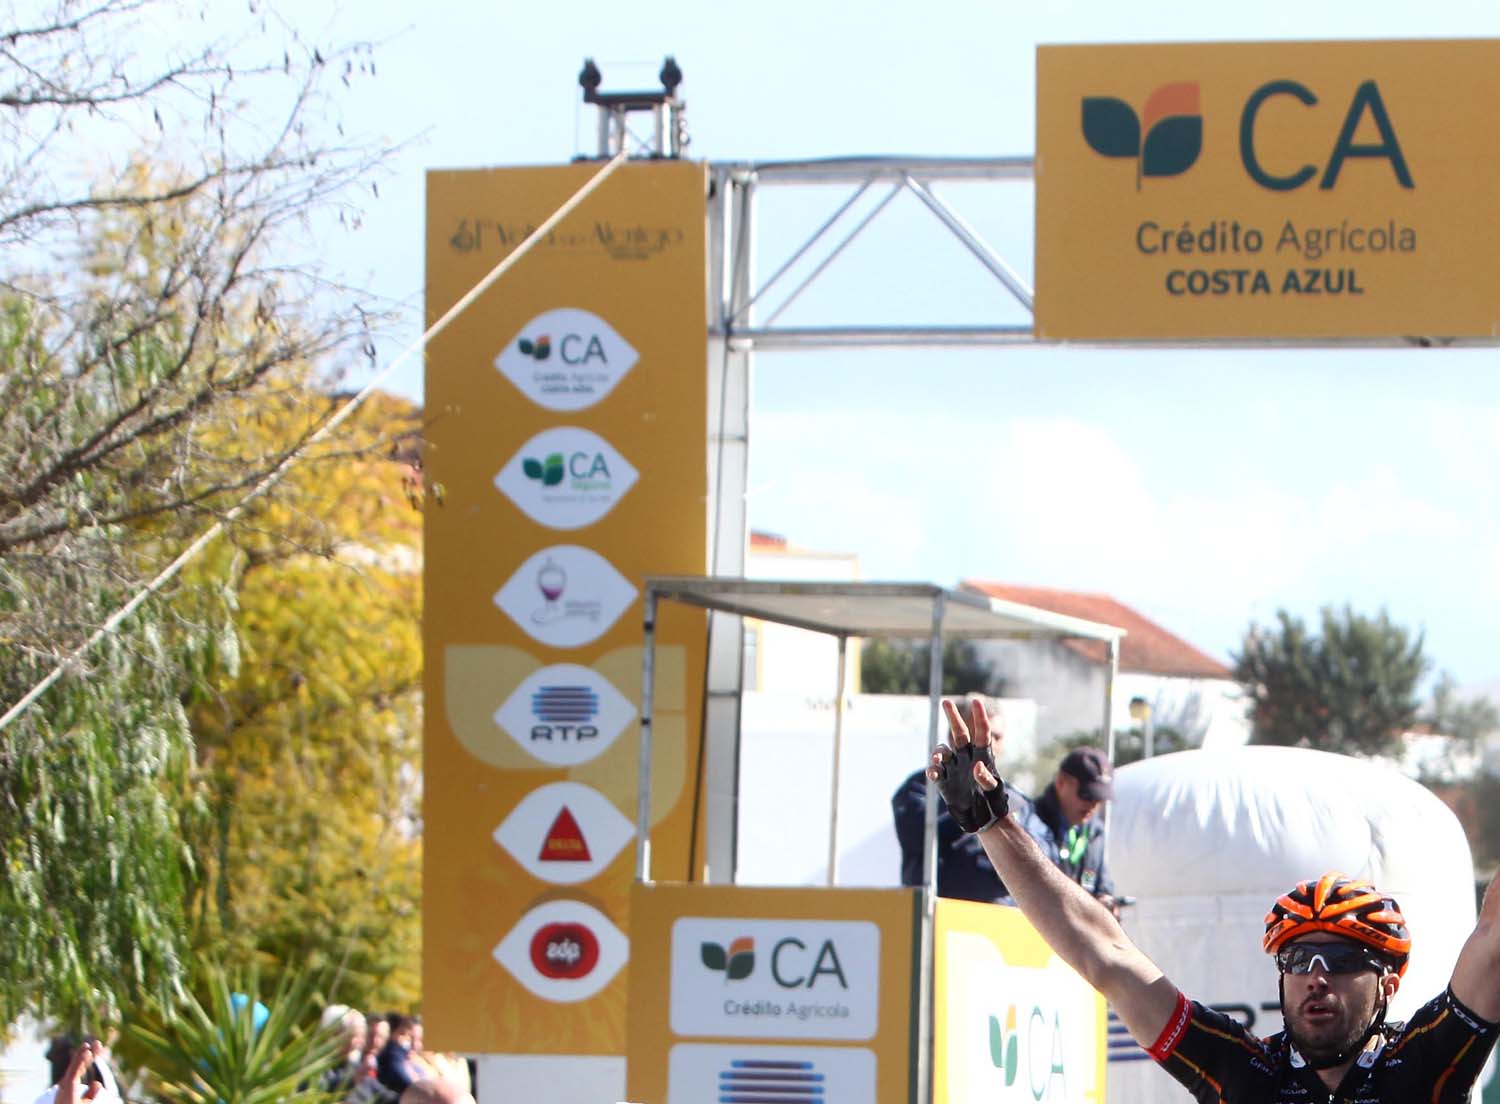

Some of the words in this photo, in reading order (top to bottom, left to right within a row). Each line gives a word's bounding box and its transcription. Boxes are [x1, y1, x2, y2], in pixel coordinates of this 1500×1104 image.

[1239, 78, 1416, 192] CA
[1135, 220, 1263, 255] Crédito
[1275, 219, 1417, 259] Agrícola
[1165, 269, 1271, 296] COSTA
[1282, 269, 1364, 295] AZUL
[560, 333, 609, 366] CA
[569, 451, 612, 480] CA
[530, 724, 599, 742] RTP
[545, 938, 582, 965] edp
[771, 937, 849, 990] CA
[723, 999, 782, 1017] Crédito
[786, 999, 850, 1020] Agrícola
[1027, 1005, 1067, 1101] CA
